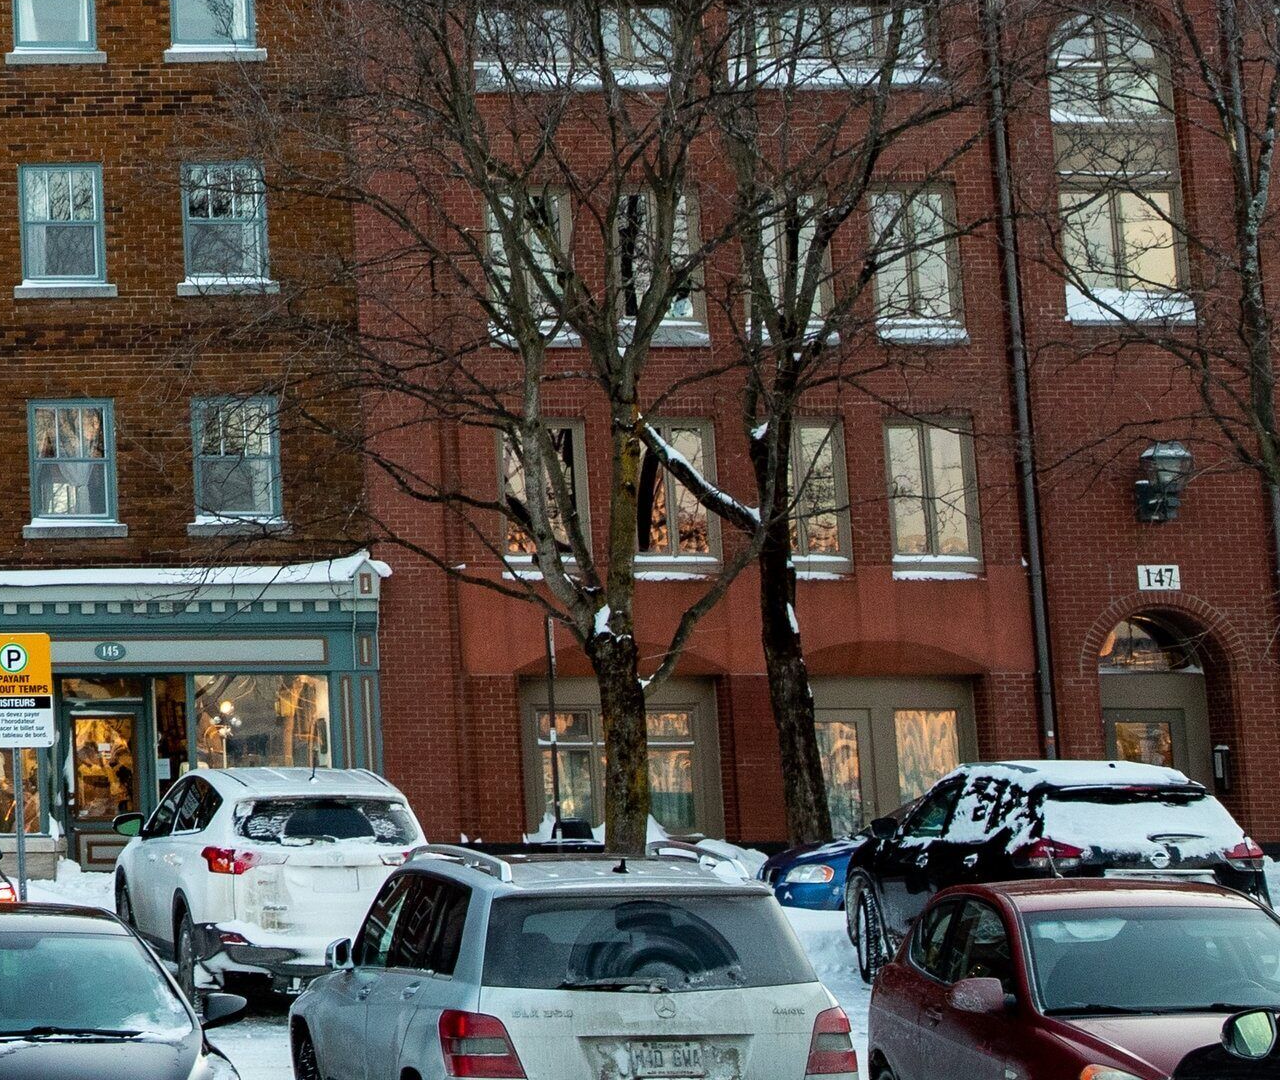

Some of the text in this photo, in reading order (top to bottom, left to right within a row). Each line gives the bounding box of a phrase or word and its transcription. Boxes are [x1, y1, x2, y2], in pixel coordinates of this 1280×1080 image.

[1144, 568, 1173, 587] 147
[102, 645, 119, 657] 145
[18, 684, 48, 693] TEMPS
